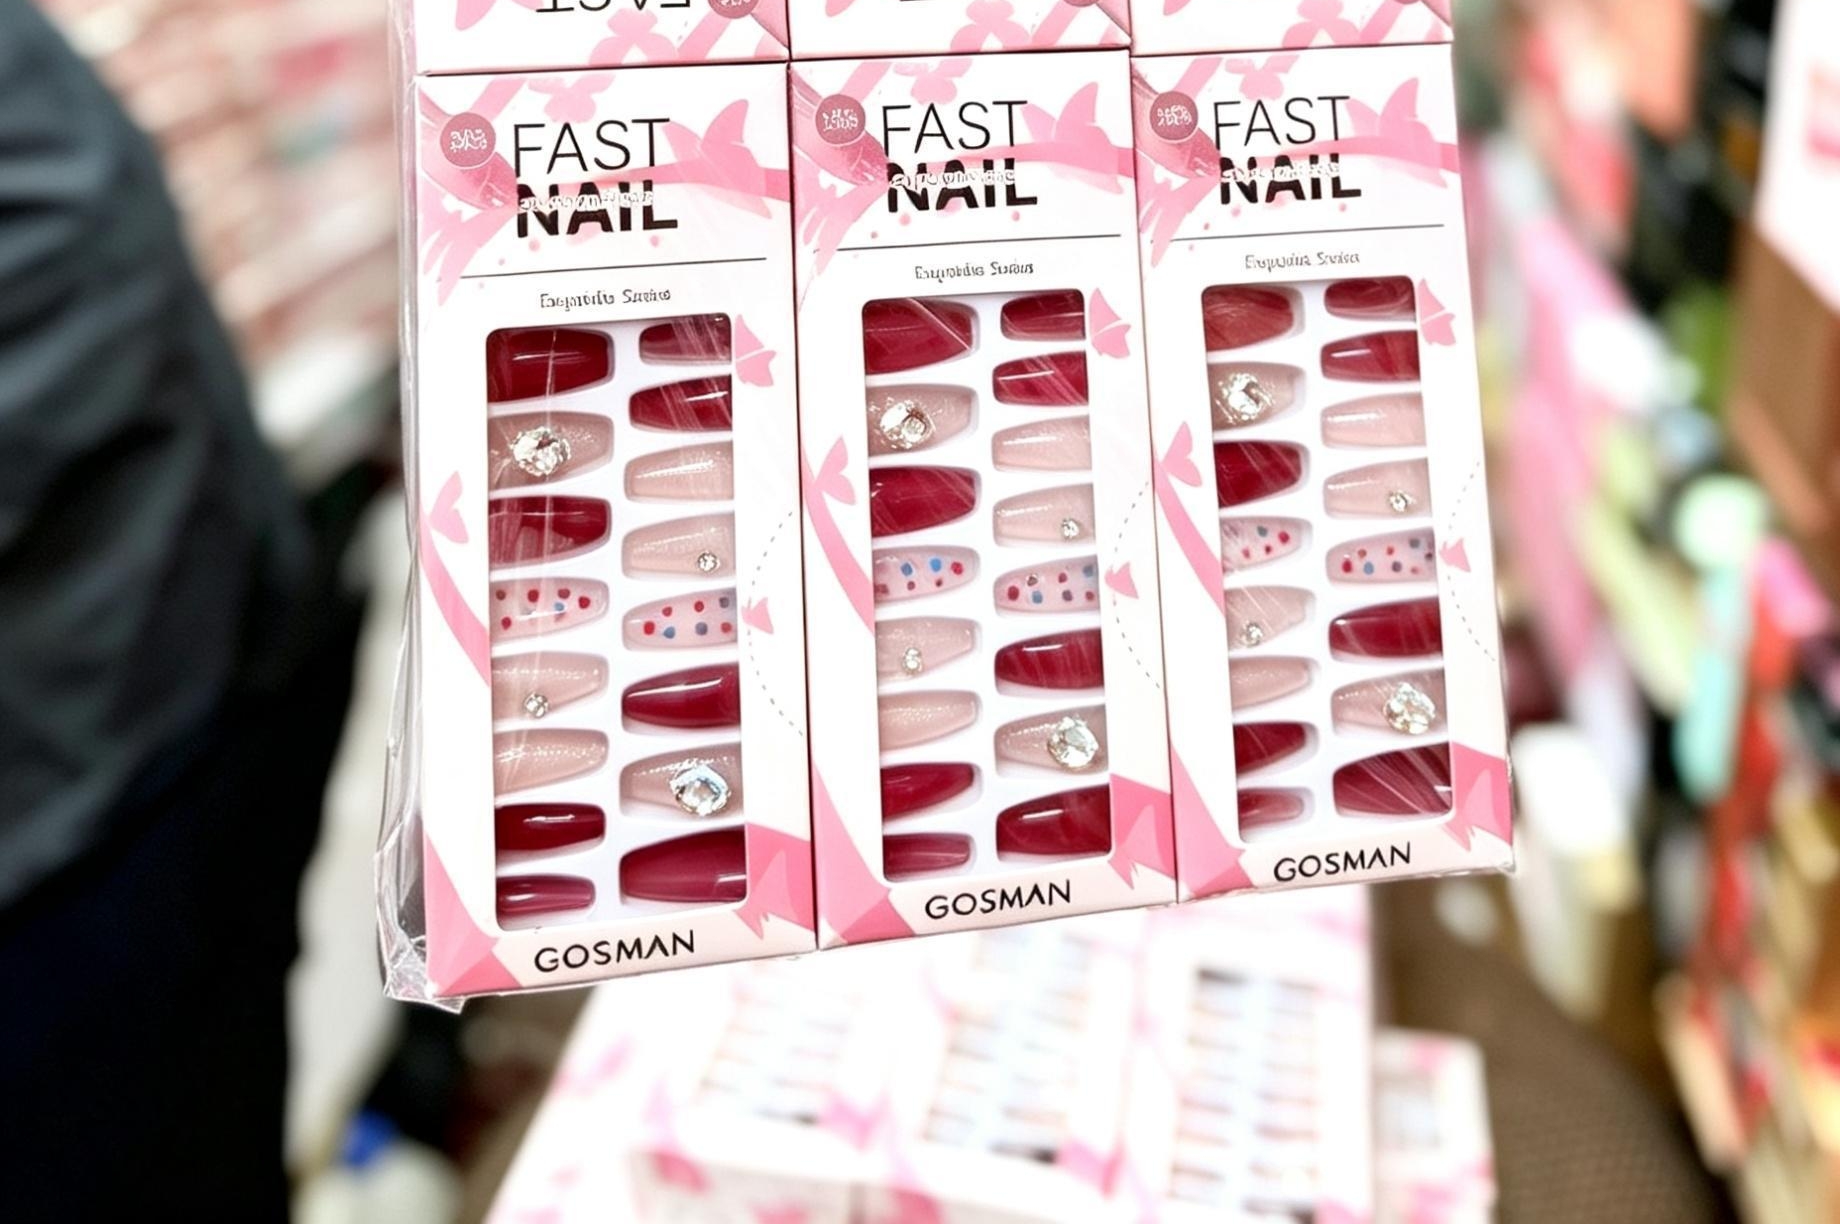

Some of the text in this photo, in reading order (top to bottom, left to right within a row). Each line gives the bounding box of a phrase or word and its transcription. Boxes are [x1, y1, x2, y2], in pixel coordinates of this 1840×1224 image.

[514, 117, 670, 178] FAST
[882, 100, 1028, 157] FAST
[1213, 95, 1350, 151] FAST
[886, 157, 1038, 213] NAIL
[1219, 152, 1363, 205] NAIL
[516, 179, 679, 239] NAIL
[1272, 841, 1412, 883] GOSMAN
[924, 880, 1073, 921] GOSMAN
[534, 929, 696, 974] GOSMAN
